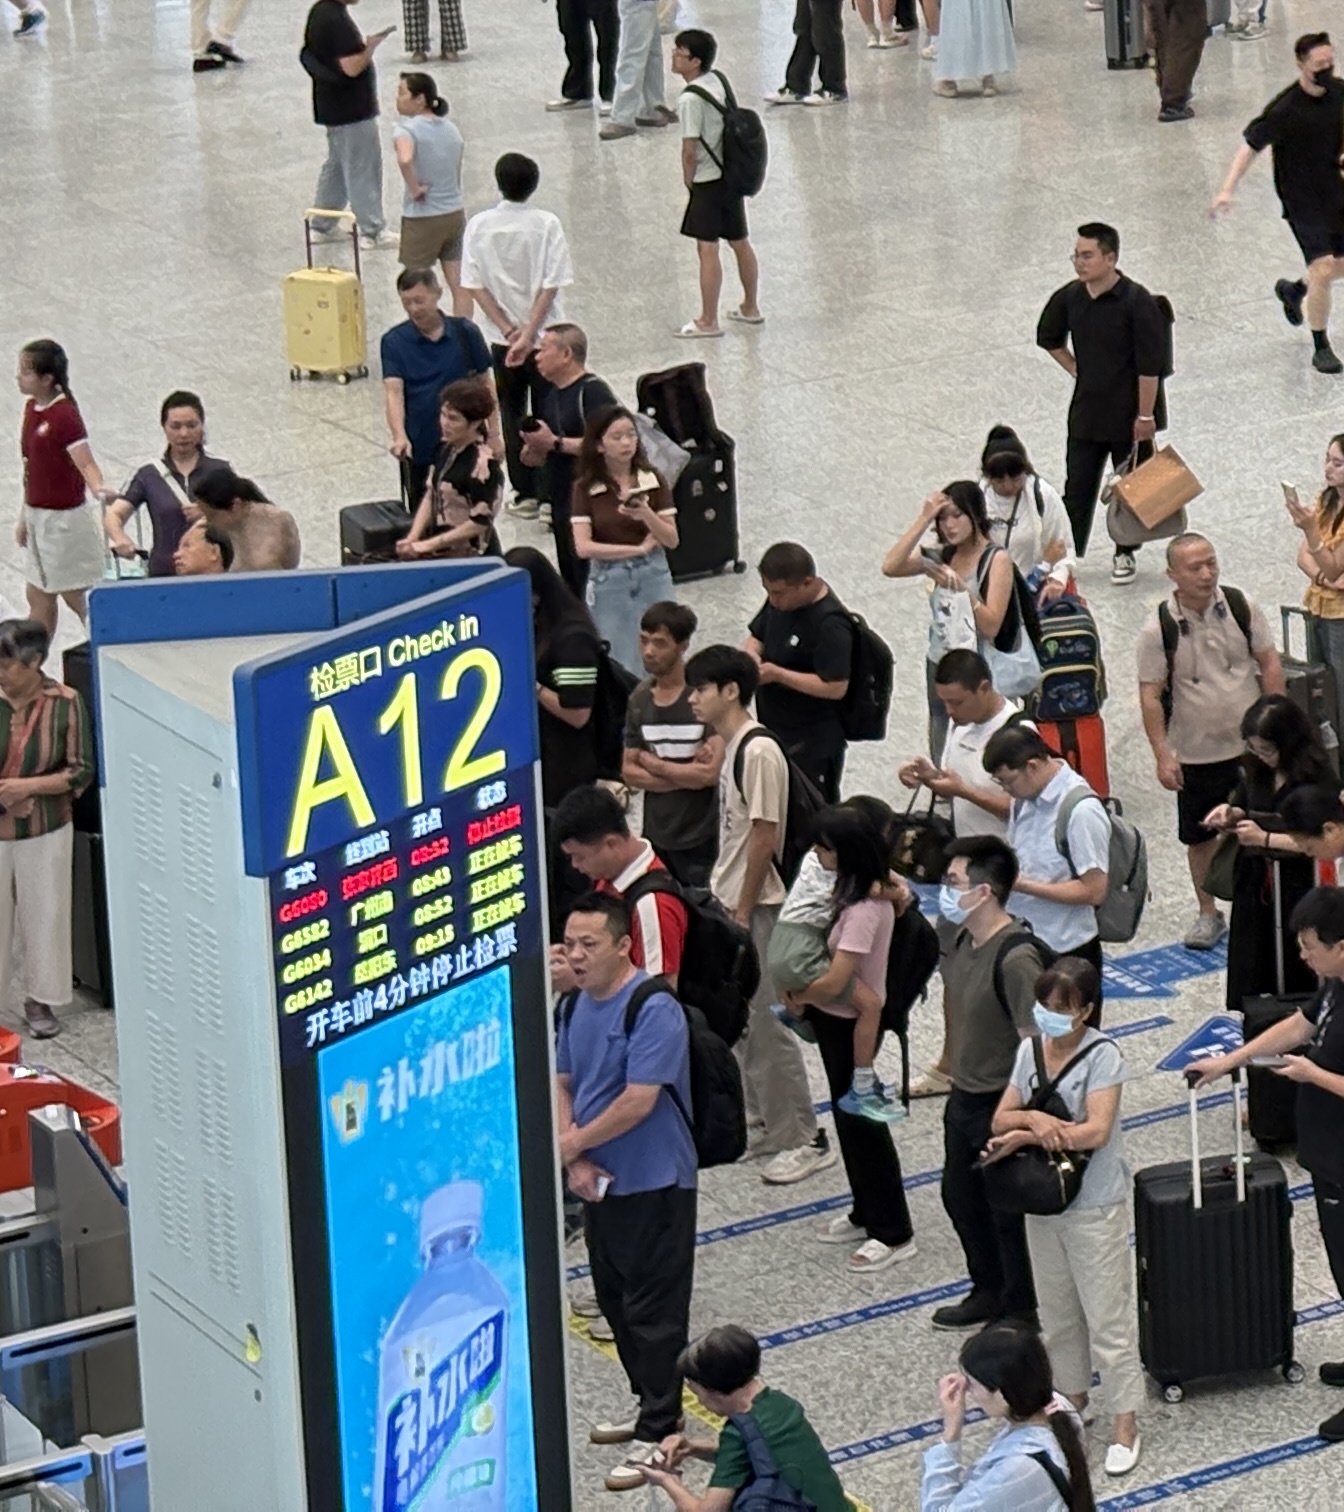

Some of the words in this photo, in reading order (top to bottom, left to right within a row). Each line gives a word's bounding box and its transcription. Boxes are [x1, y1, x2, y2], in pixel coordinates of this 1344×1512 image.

[310, 645, 383, 702] 检票口
[387, 620, 457, 668] Check
[459, 613, 479, 642] in
[285, 648, 507, 858] A12
[467, 833, 524, 876] 正在候车
[469, 862, 525, 905] 正在候车
[471, 891, 527, 934] 正在候车
[306, 921, 518, 1048] 开车前4分钟停止检票
[375, 1016, 501, 1124] 补水啦
